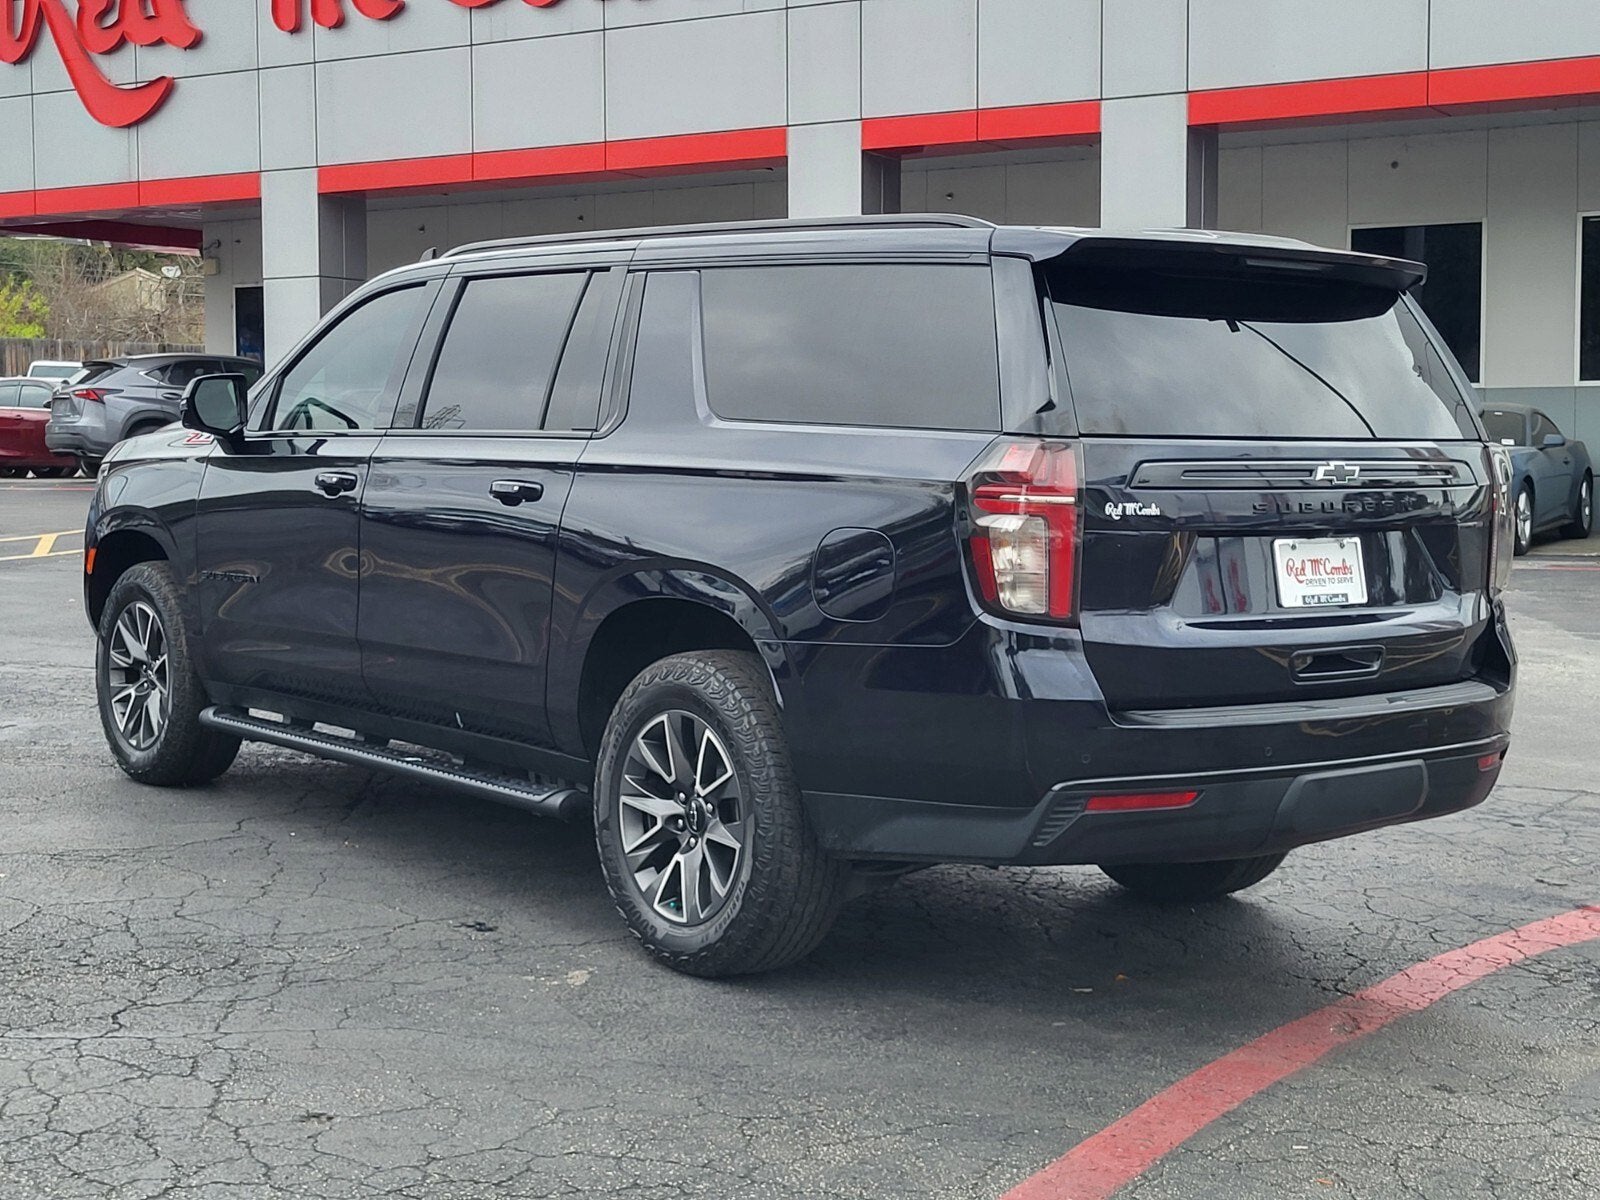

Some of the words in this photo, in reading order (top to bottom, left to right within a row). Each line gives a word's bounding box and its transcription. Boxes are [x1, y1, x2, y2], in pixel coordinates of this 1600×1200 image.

[1105, 502, 1123, 520] Red
[1286, 557, 1307, 584] Red
[1307, 558, 1353, 577] McCombs
[1305, 578, 1327, 586] DRIVEN
